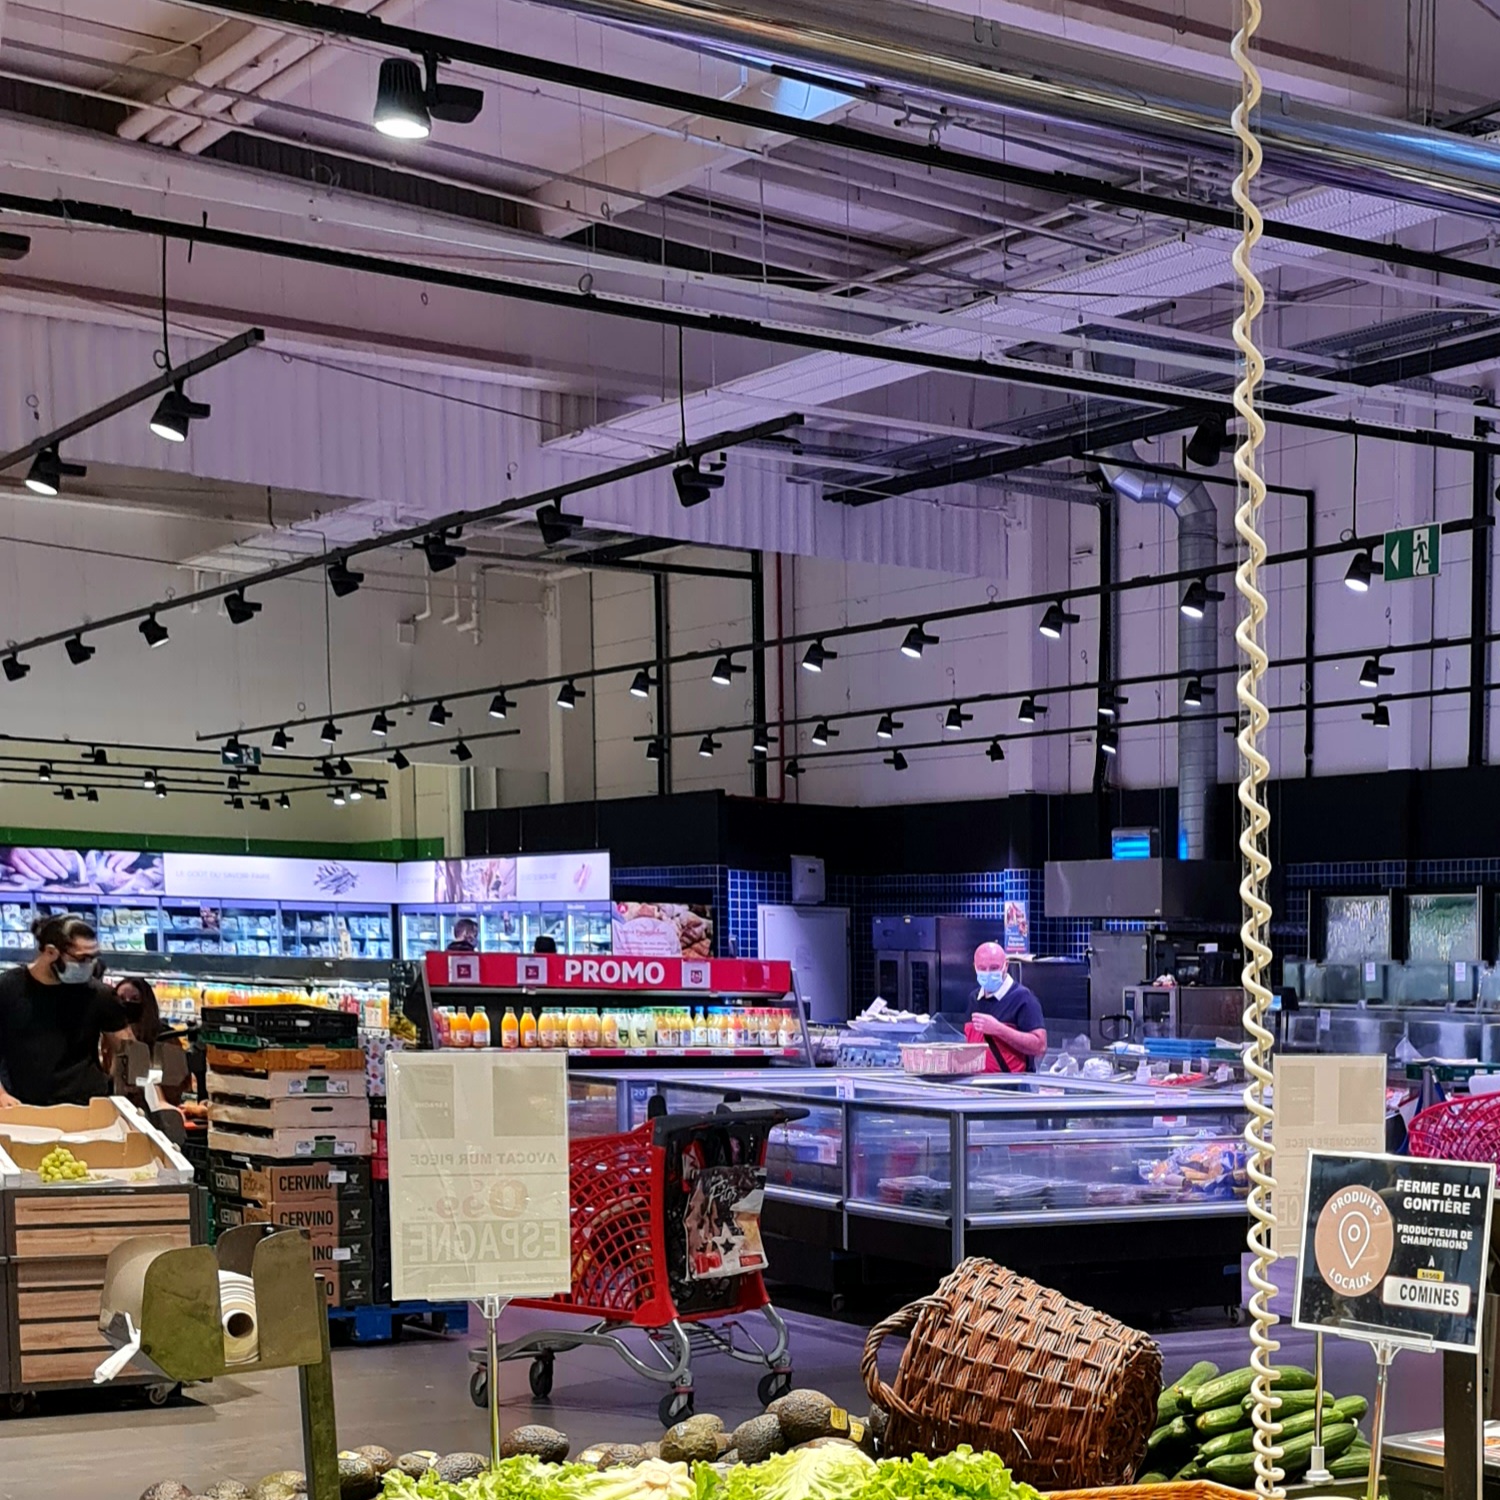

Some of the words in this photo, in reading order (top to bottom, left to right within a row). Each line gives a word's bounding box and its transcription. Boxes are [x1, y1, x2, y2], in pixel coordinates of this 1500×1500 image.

[564, 960, 665, 985] PROMO
[279, 1175, 333, 1192] CERVINO
[1396, 1179, 1440, 1196] FERME
[1443, 1183, 1461, 1198] DE
[1464, 1185, 1482, 1199] LA
[1331, 1192, 1383, 1217] PRODUITS
[1402, 1196, 1471, 1216] GONTIÈRE
[280, 1210, 334, 1226] CERVINO
[1397, 1223, 1455, 1240] PRODUCTEUR
[1457, 1230, 1473, 1241] DE
[1401, 1234, 1469, 1250] CHAMPIGNONS
[1329, 1267, 1373, 1290] LOCAUX
[1399, 1283, 1460, 1307] COMINES
